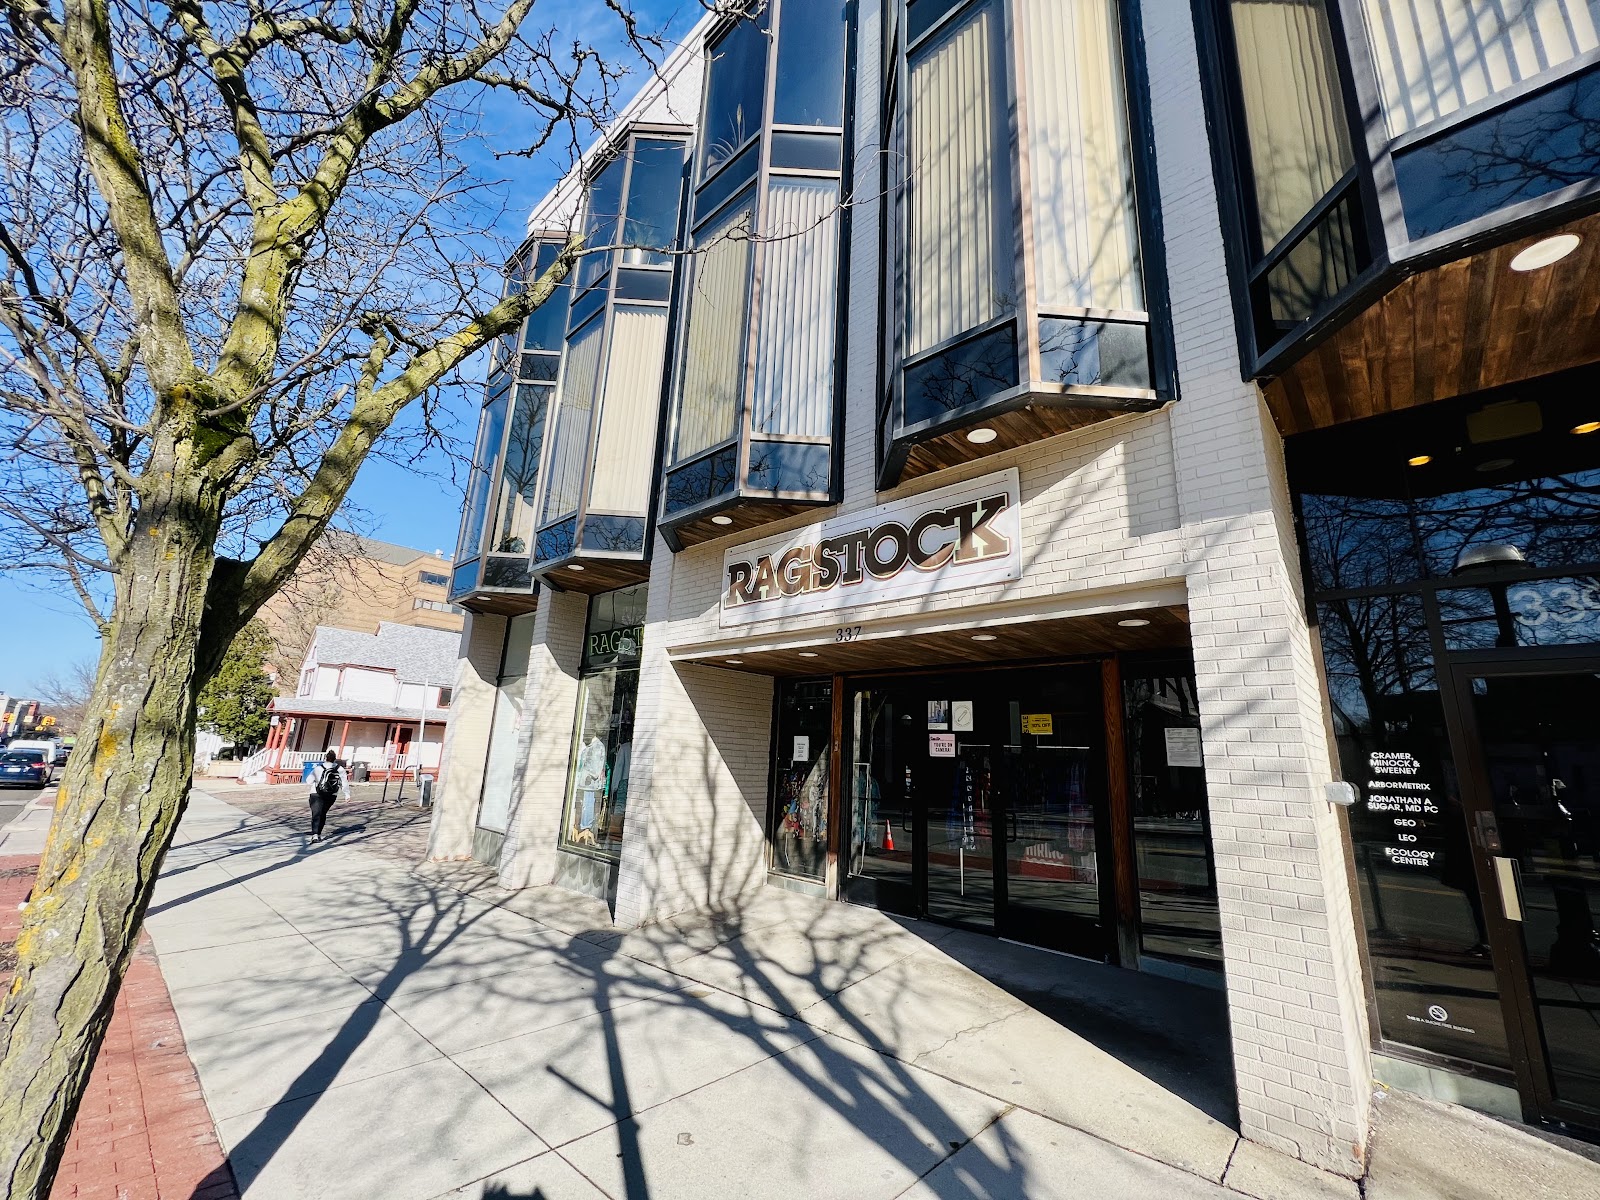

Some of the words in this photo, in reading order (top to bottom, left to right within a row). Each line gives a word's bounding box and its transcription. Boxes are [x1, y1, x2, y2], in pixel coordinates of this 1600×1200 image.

[724, 492, 1010, 610] RAGSTOCK
[835, 626, 862, 642] 337
[1370, 752, 1414, 760] CRAMER,
[1369, 759, 1411, 768] MINOCK
[1412, 760, 1421, 768] &
[1368, 795, 1421, 804] JONATHAN
[1367, 802, 1404, 812] SUGAR,
[1405, 804, 1422, 813] MD
[1424, 805, 1439, 814] PC
[1394, 819, 1416, 827] GEO
[1398, 834, 1417, 842] LEO
[1385, 848, 1435, 859] ECOLOGY
[1392, 857, 1429, 866] CENTER
